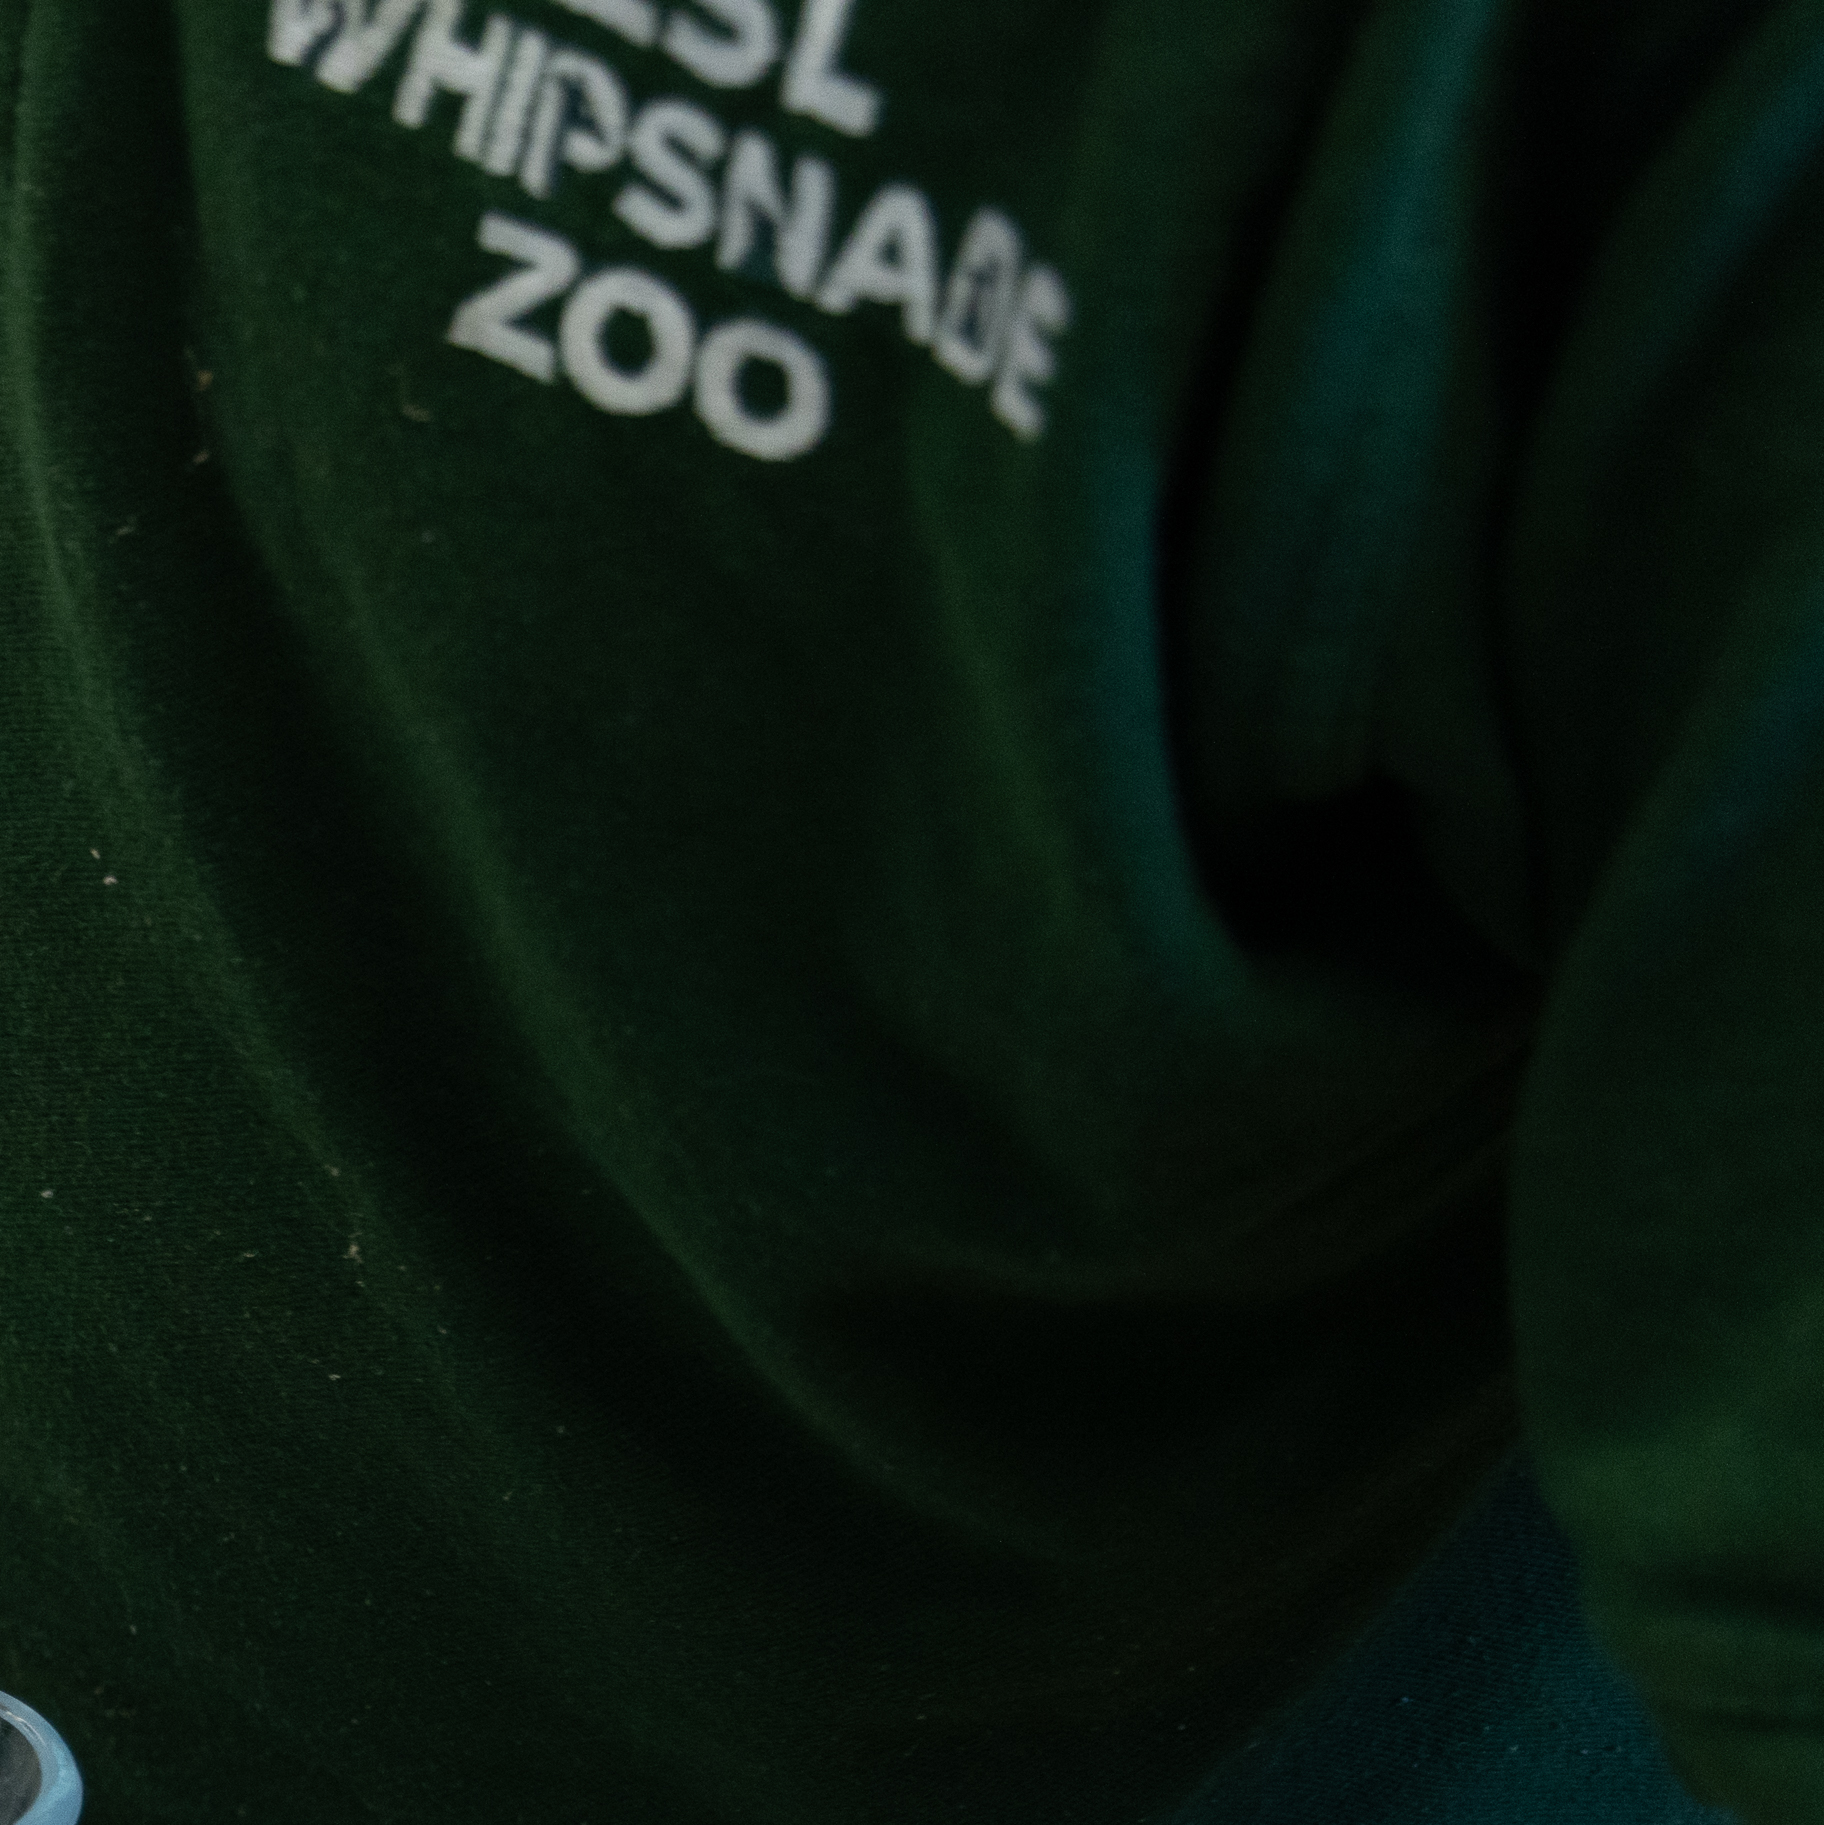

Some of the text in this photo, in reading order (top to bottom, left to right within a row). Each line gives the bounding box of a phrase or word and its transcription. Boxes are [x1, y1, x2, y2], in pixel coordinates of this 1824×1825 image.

[558, 0, 883, 138] SL
[266, 0, 1071, 441] WHIPSNADE
[446, 211, 832, 462] ZOO
